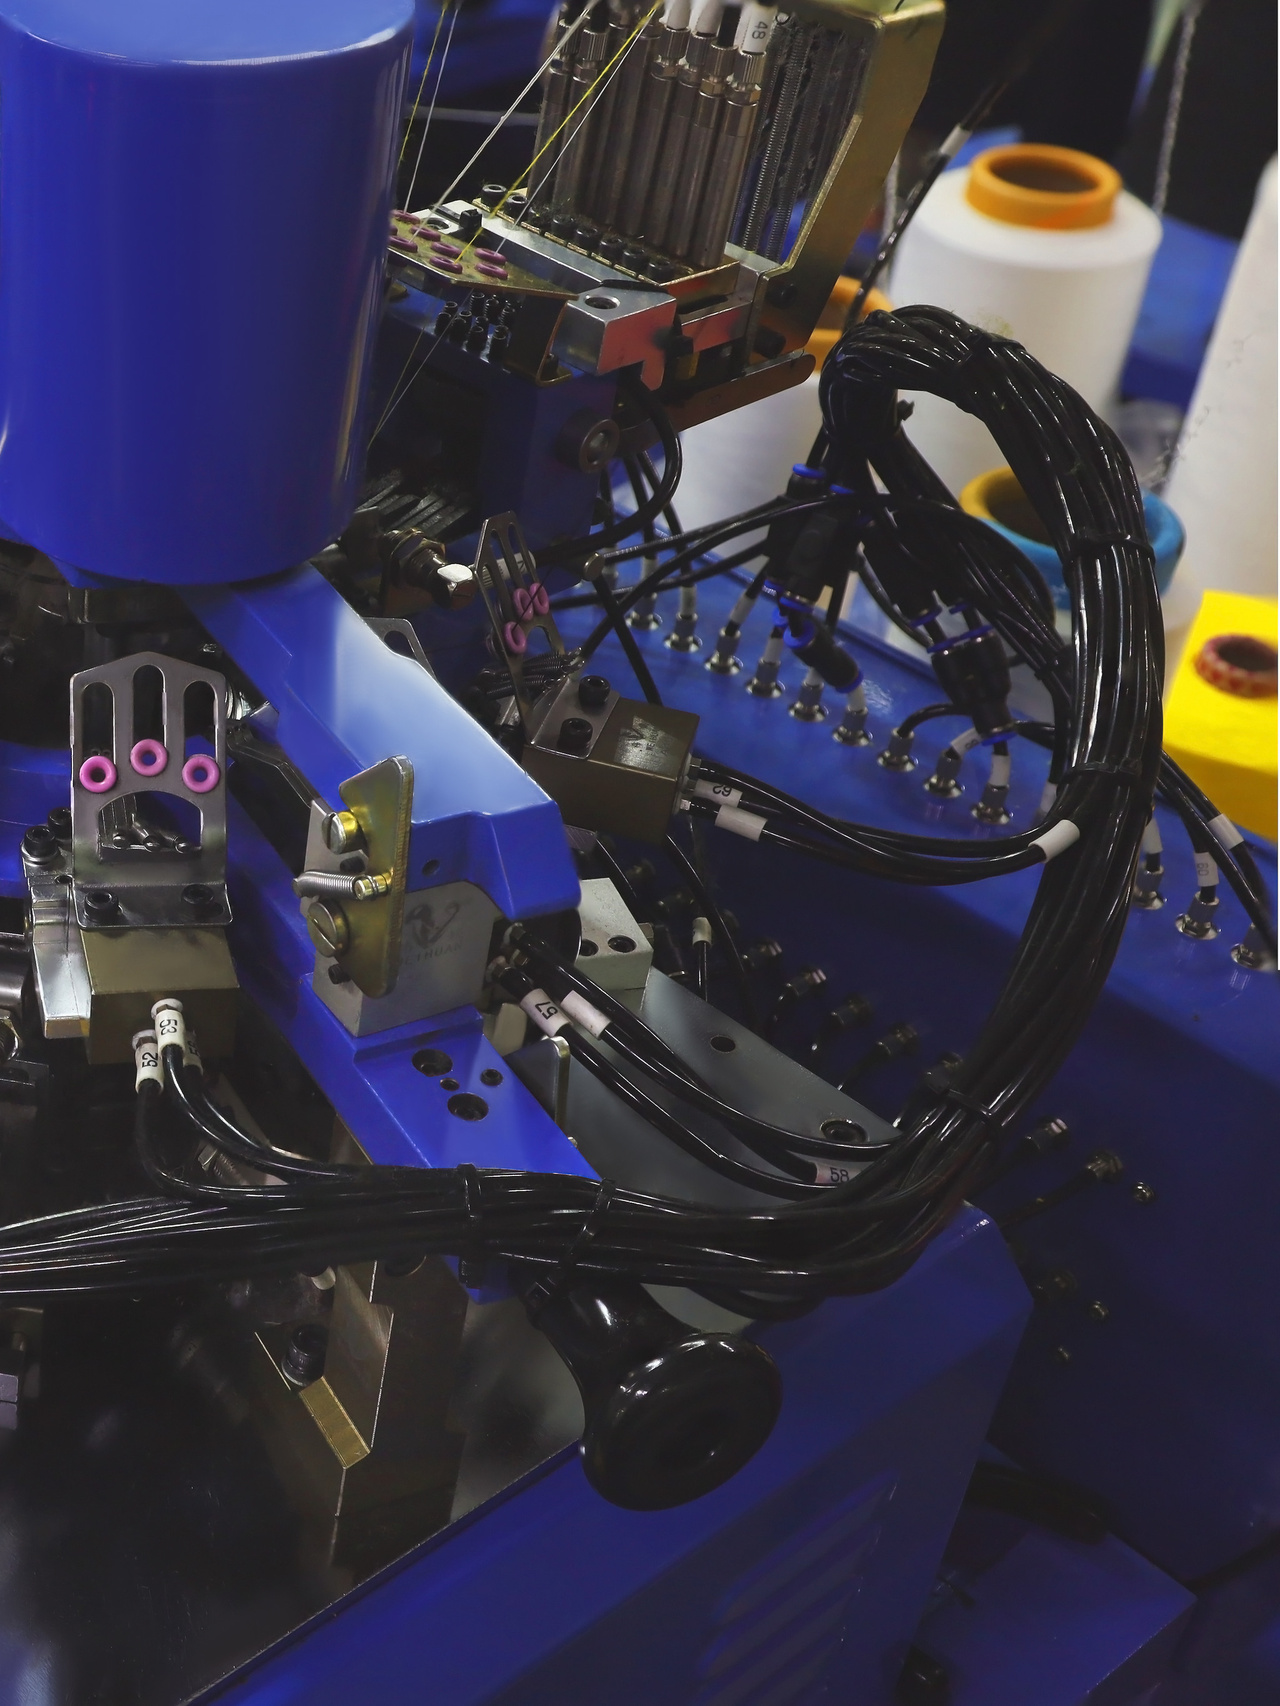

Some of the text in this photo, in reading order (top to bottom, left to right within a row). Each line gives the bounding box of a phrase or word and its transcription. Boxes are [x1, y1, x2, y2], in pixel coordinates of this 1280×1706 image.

[751, 20, 769, 40] 48
[534, 1001, 559, 1020] 57
[159, 1018, 178, 1036] 53
[141, 1052, 159, 1068] 52
[829, 1167, 850, 1183] 58
